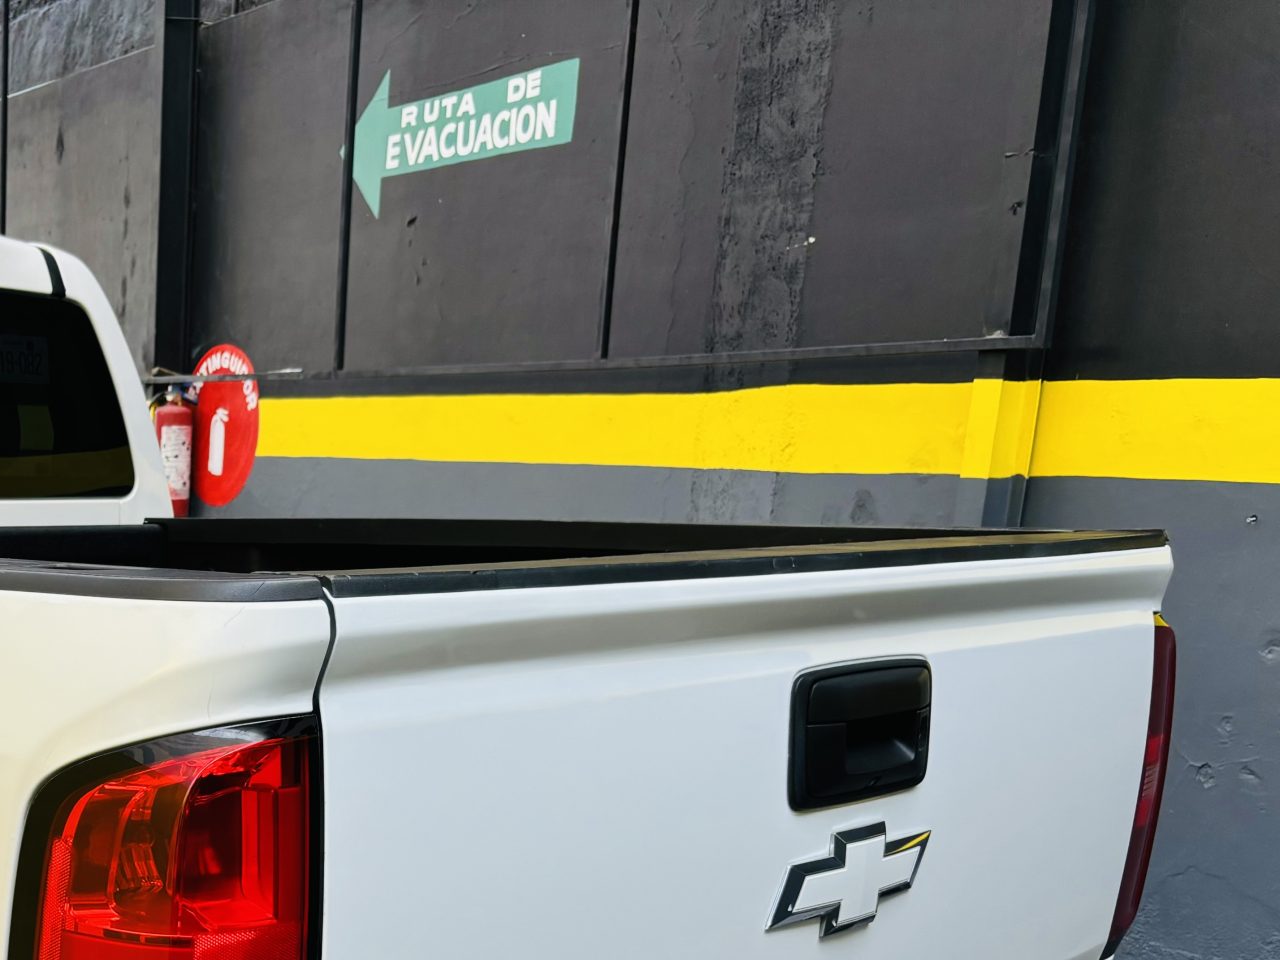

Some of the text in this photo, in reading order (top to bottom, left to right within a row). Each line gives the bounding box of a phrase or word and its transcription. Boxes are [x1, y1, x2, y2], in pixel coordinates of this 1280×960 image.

[401, 70, 542, 128] RUTA DE
[385, 99, 558, 170] EVACUACION
